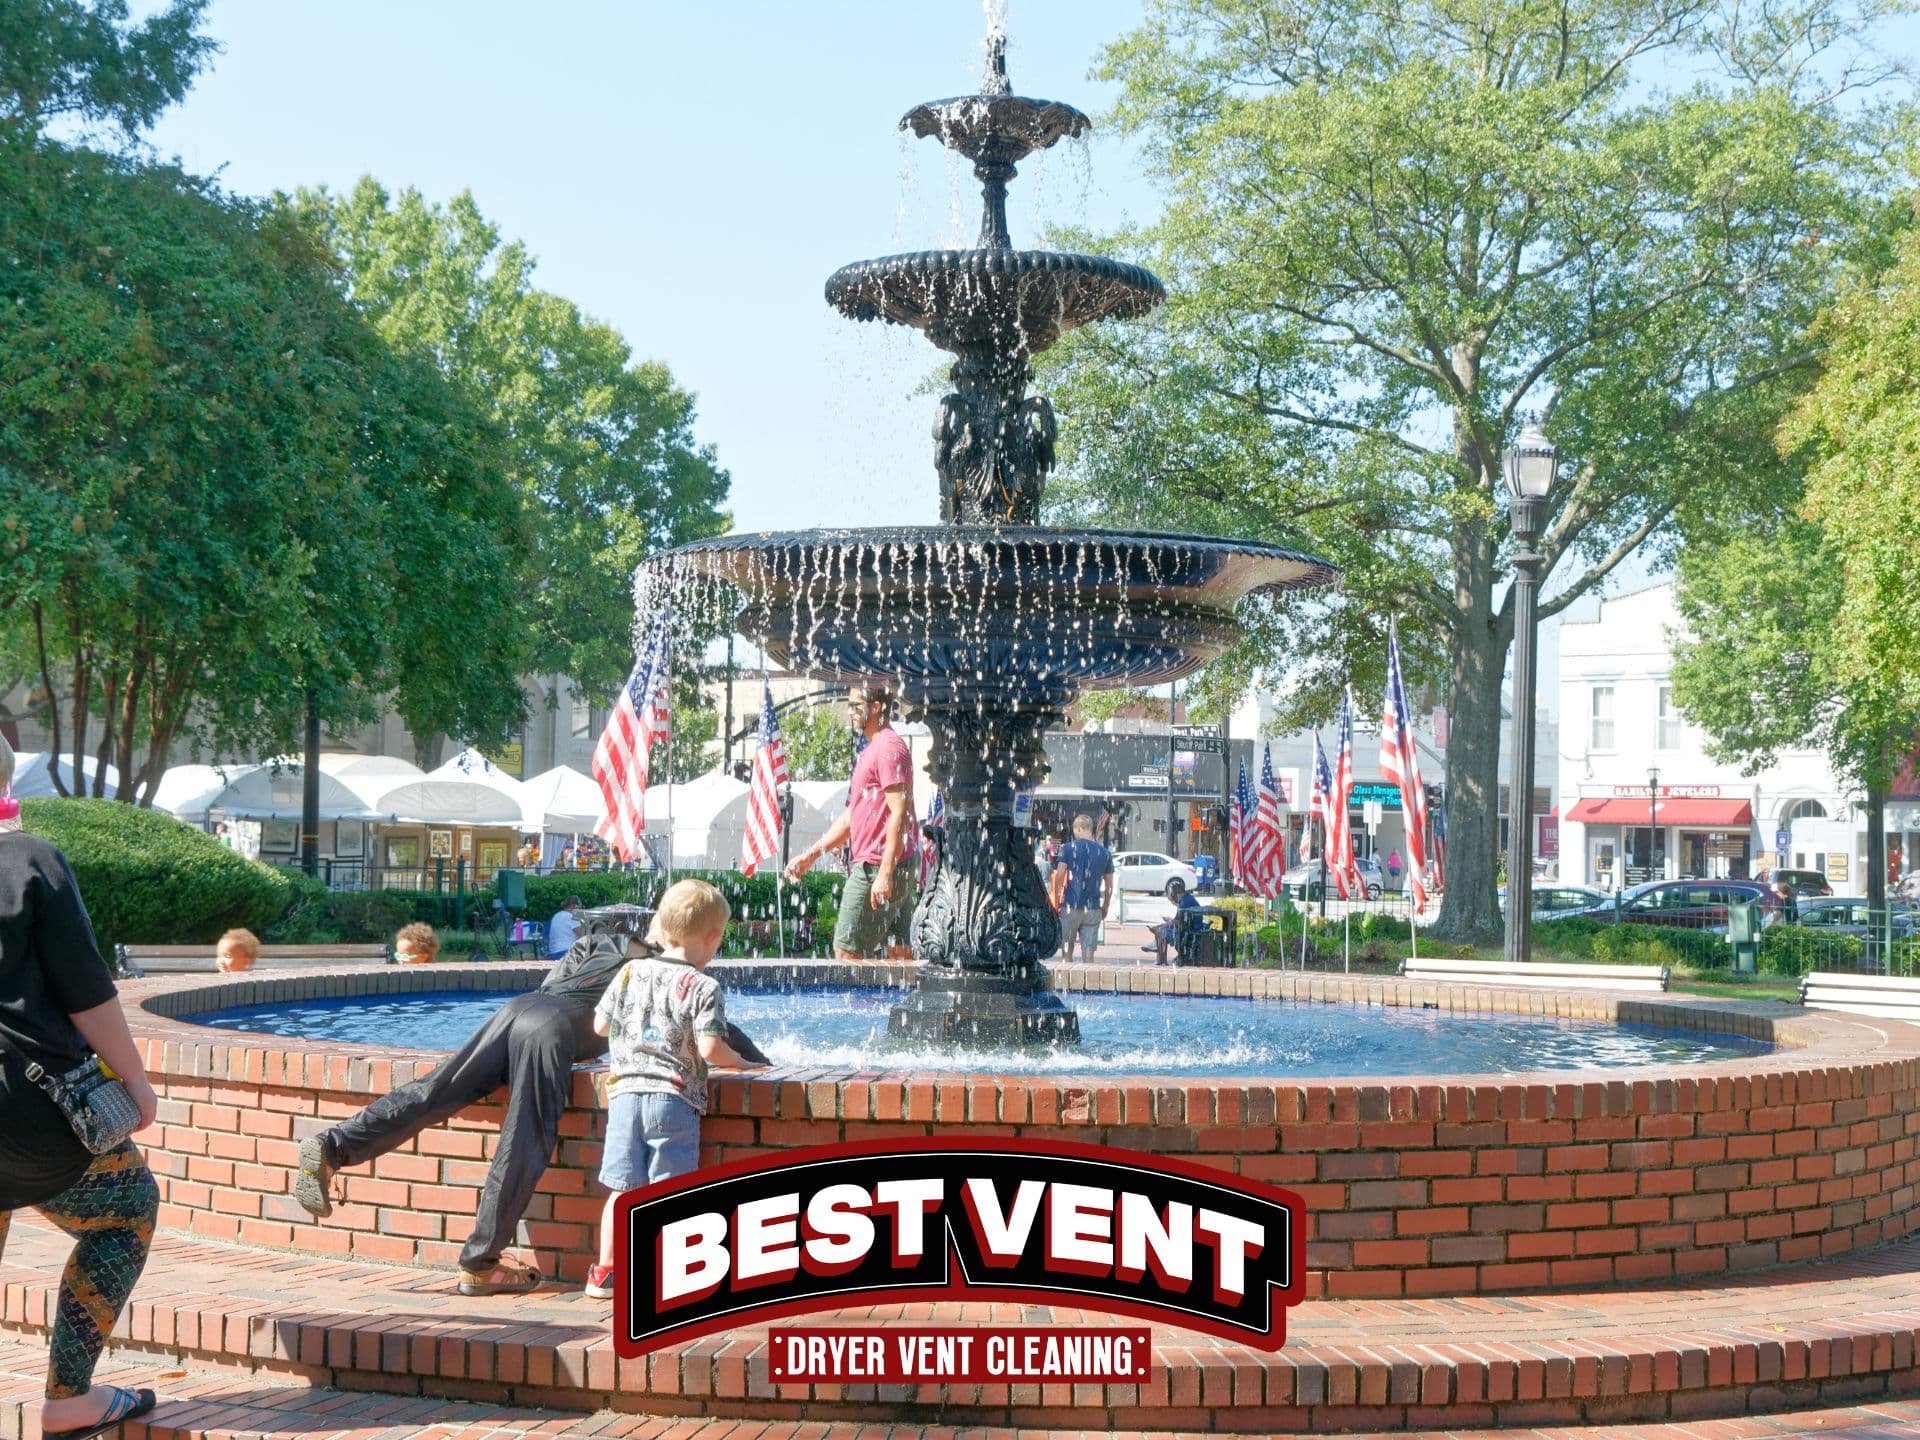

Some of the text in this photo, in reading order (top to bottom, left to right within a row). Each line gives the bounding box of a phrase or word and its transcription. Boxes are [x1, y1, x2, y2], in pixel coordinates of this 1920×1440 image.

[1190, 727, 1204, 737] Park
[1194, 740, 1207, 751] Park
[1353, 785, 1371, 794] Glass
[1668, 786, 1719, 797] JEWELERS
